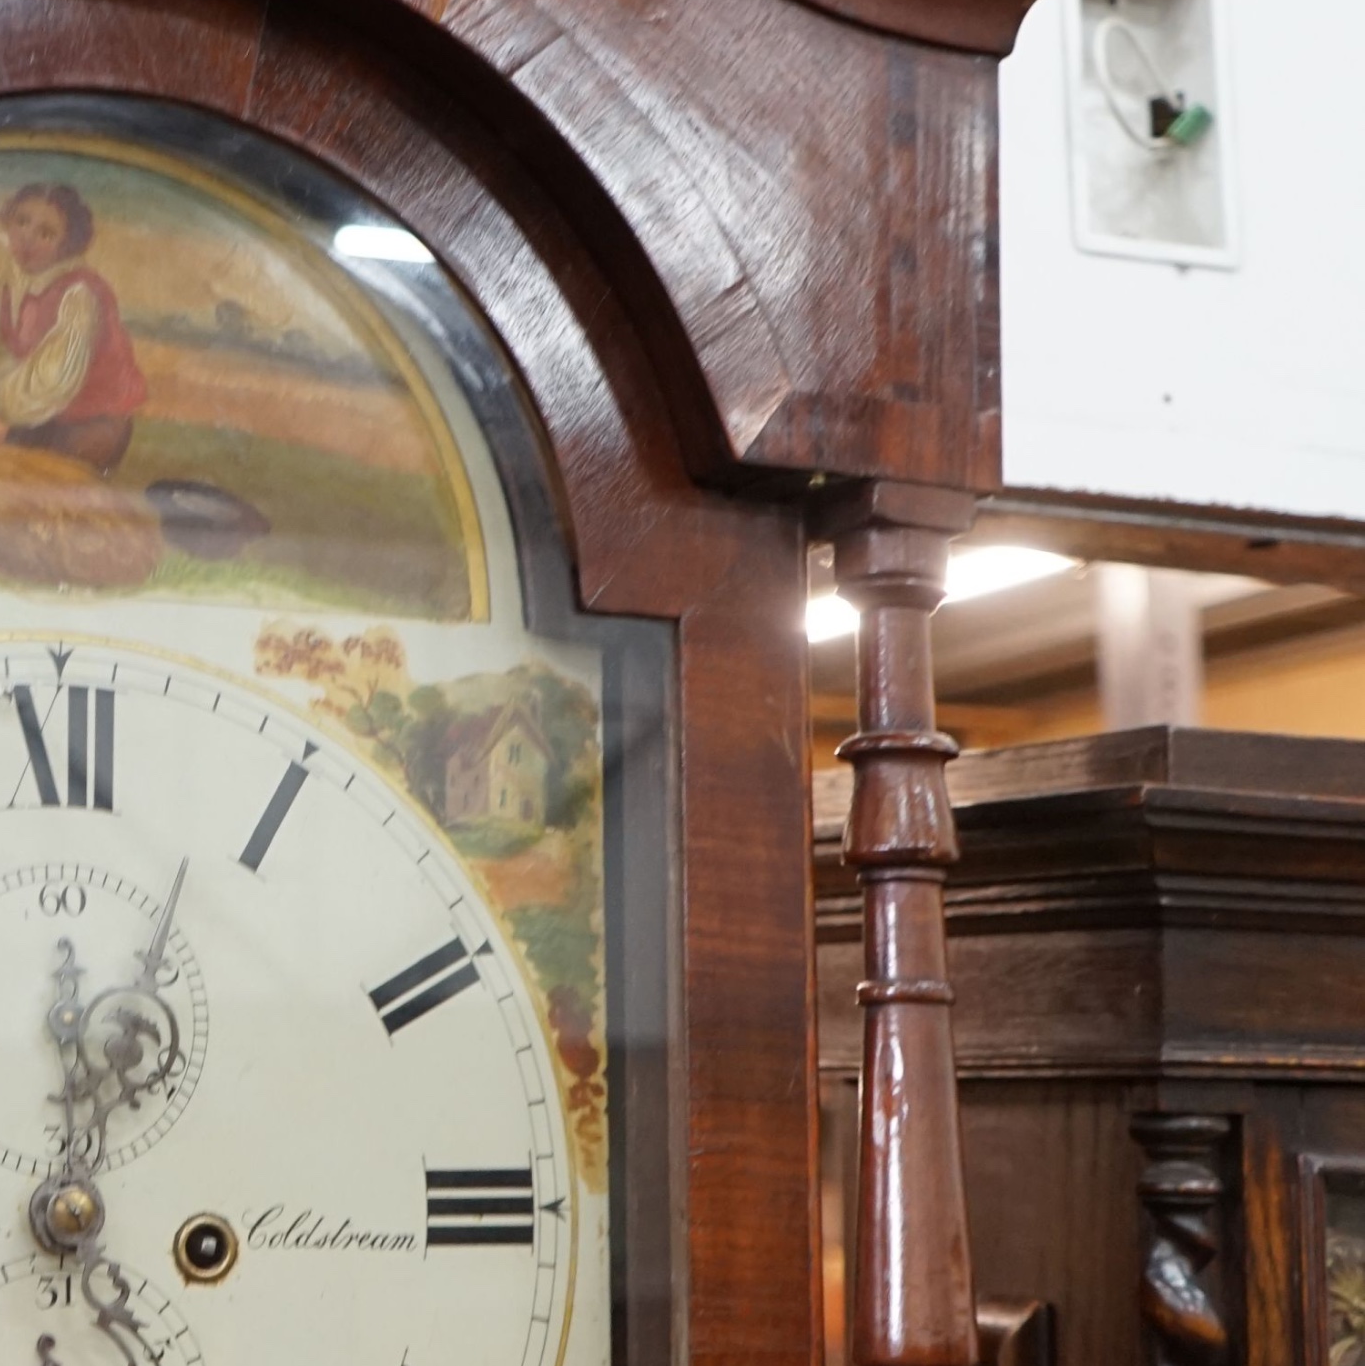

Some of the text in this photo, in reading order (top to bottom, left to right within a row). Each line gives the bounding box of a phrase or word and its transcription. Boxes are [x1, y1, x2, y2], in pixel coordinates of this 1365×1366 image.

[6, 683, 116, 813] XII
[237, 758, 311, 873] I
[39, 883, 86, 917] 60
[367, 935, 483, 1037] II
[240, 1205, 418, 1254] Coldstream
[424, 1165, 535, 1258] III
[35, 1275, 72, 1309] 31
